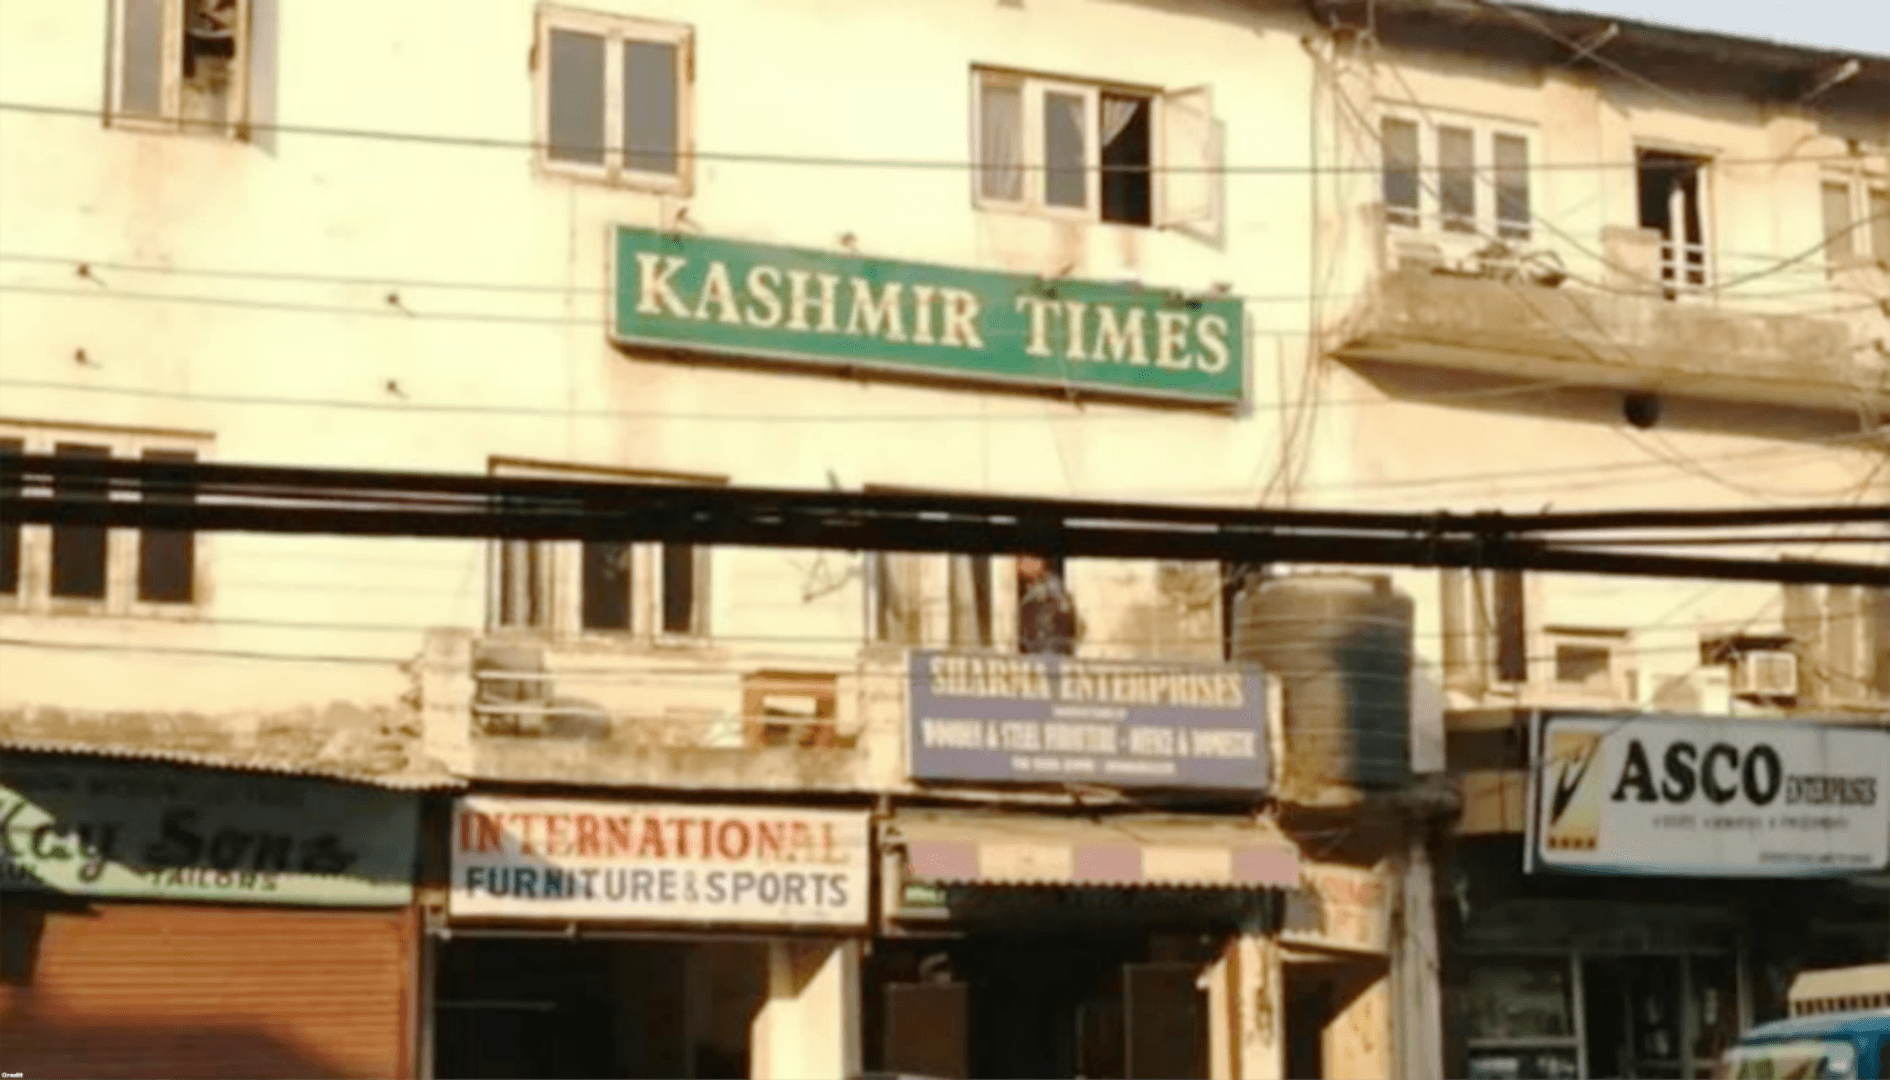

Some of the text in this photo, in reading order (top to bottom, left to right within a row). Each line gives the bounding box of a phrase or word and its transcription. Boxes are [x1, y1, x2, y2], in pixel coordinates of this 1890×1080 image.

[635, 252, 1229, 374] KASHMIR TIMES
[930, 656, 1244, 707] SHARMA ENTERPRISES
[1610, 738, 1783, 806] ASCO
[460, 811, 851, 865] INTERNATIONAL
[148, 866, 279, 891] TAILORS
[706, 871, 849, 907] SPORTS
